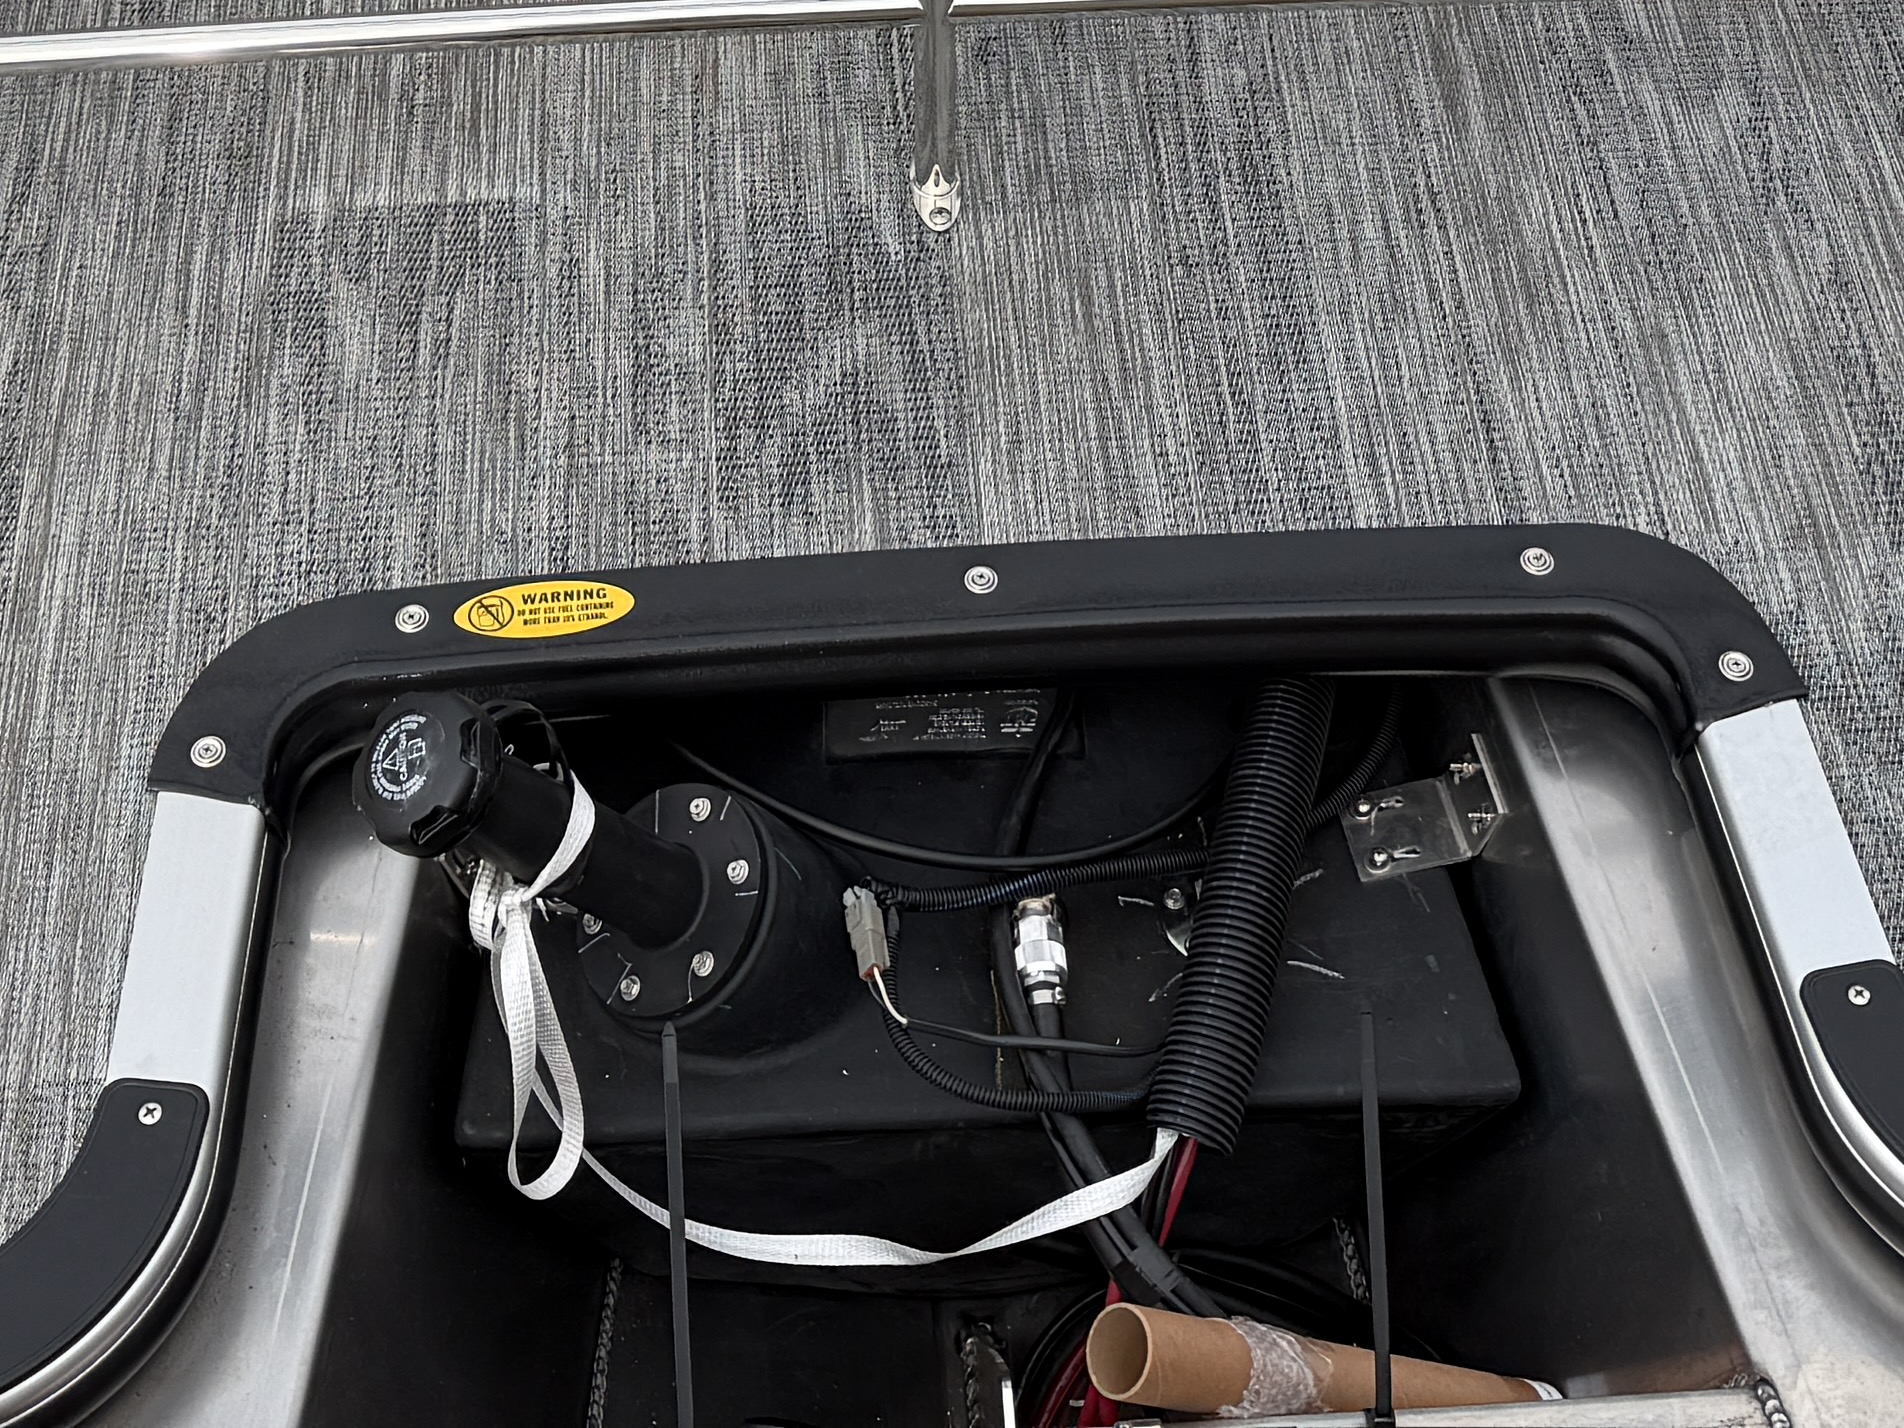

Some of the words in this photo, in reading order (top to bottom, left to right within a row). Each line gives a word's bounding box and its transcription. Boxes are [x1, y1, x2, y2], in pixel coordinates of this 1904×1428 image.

[521, 587, 608, 605] WARNING
[558, 604, 573, 613] FUEL
[543, 615, 560, 624] THAN
